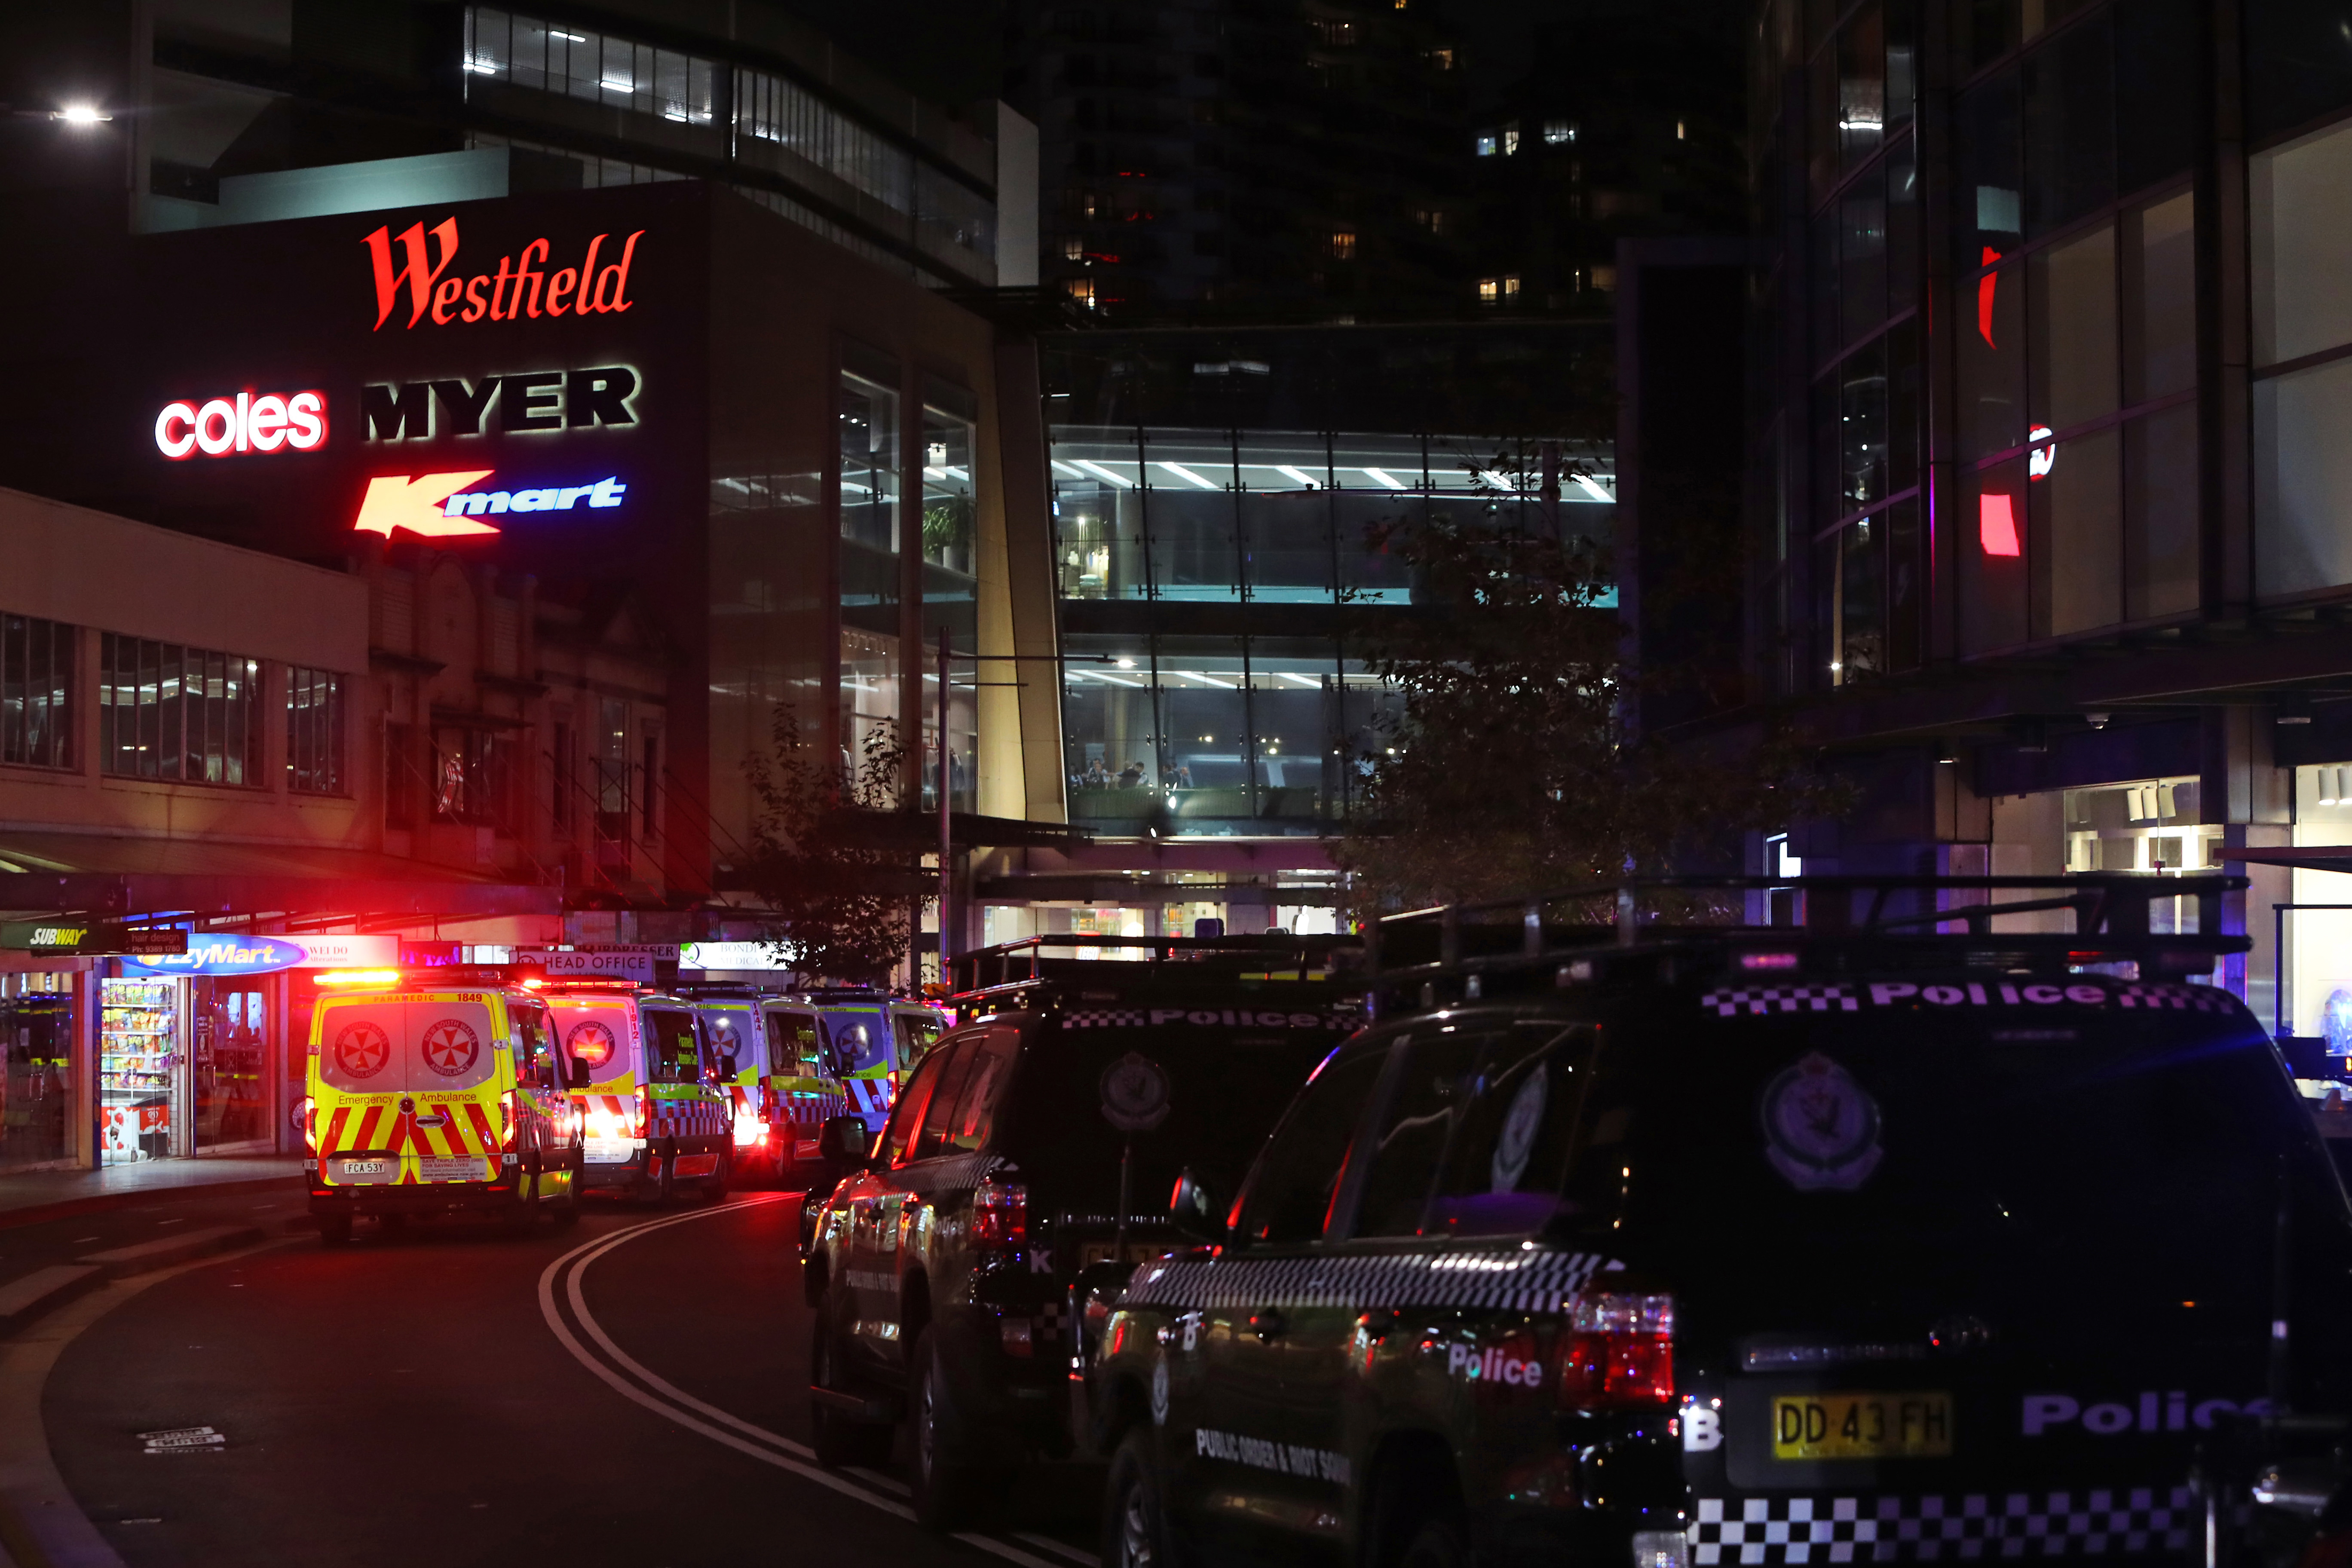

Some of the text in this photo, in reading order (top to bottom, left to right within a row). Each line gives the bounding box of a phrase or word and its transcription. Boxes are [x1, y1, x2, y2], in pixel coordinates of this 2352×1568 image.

[360, 216, 646, 332] Westfield
[360, 366, 639, 441] MYER
[155, 392, 322, 458] coles
[353, 469, 627, 539] Kmart
[30, 928, 88, 945] SUBWAY
[132, 933, 179, 944] hair design
[721, 943, 757, 952] BONDI
[544, 957, 645, 969] HEAD OFFICE
[457, 993, 482, 1002] 1849
[1868, 982, 2108, 1008] Police
[631, 1005, 639, 1039] 1912
[753, 1002, 762, 1031] 1444
[1148, 1008, 1320, 1028] Police
[425, 1020, 477, 1043] NEW SOUTH WALES
[581, 1021, 599, 1029] SOUTH
[599, 1023, 614, 1042] WALES
[343, 1065, 383, 1078] AMBULANCE
[430, 1063, 470, 1075] AMBULANCE
[339, 1093, 476, 1106] Emergency Ambulance
[349, 1163, 383, 1172] FCA 53Y
[932, 1215, 965, 1236] olice
[1031, 1249, 1053, 1273] K
[1447, 1343, 1543, 1388] Police
[1683, 1409, 1721, 1452] B
[1781, 1400, 1948, 1444] DD 43 FH
[1195, 1428, 1240, 1462] PUBLIC
